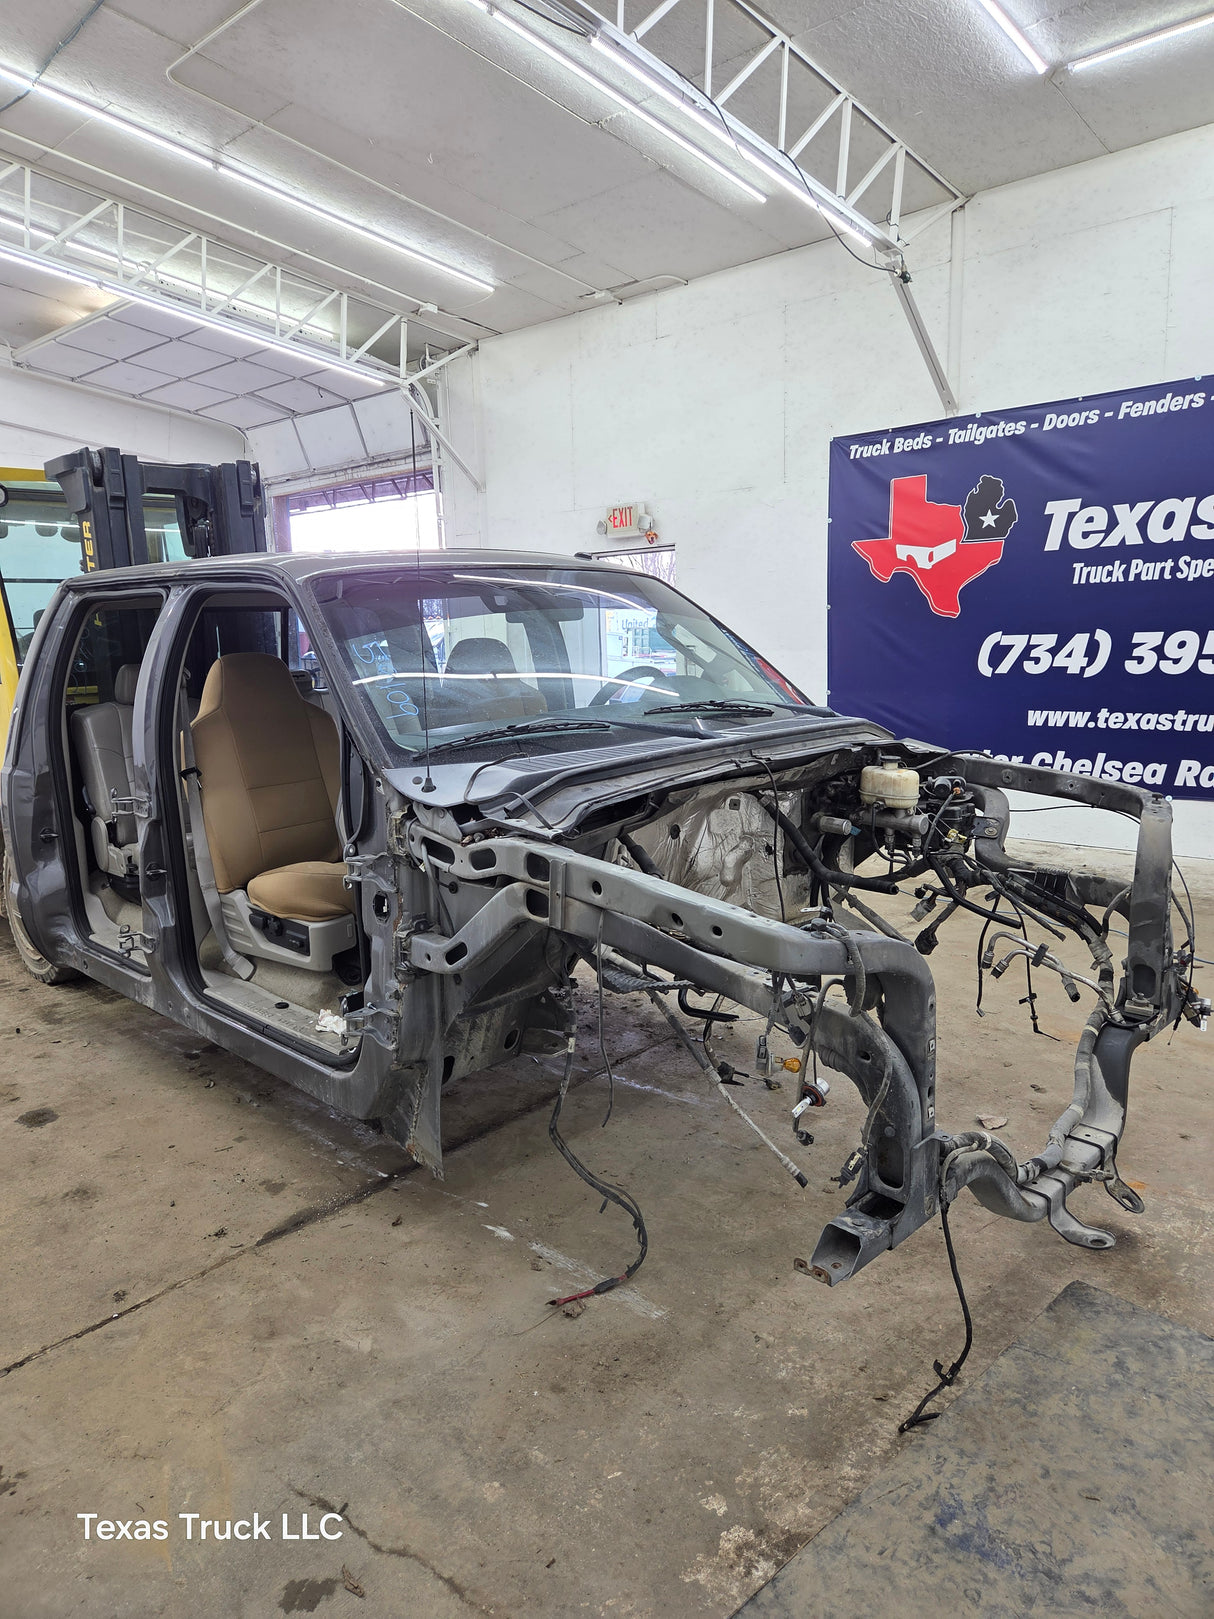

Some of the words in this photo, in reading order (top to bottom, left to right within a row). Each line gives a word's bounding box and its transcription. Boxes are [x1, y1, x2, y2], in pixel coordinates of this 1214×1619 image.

[849, 439, 891, 460] Truck
[893, 432, 932, 453] Beds
[948, 418, 1027, 445] Tailgates
[1043, 410, 1100, 432] Doors
[1118, 391, 1206, 420] Fenders
[612, 506, 633, 529] EXIT
[1072, 560, 1127, 585] Truck
[1128, 558, 1174, 582] Part
[977, 628, 1112, 678] (734)
